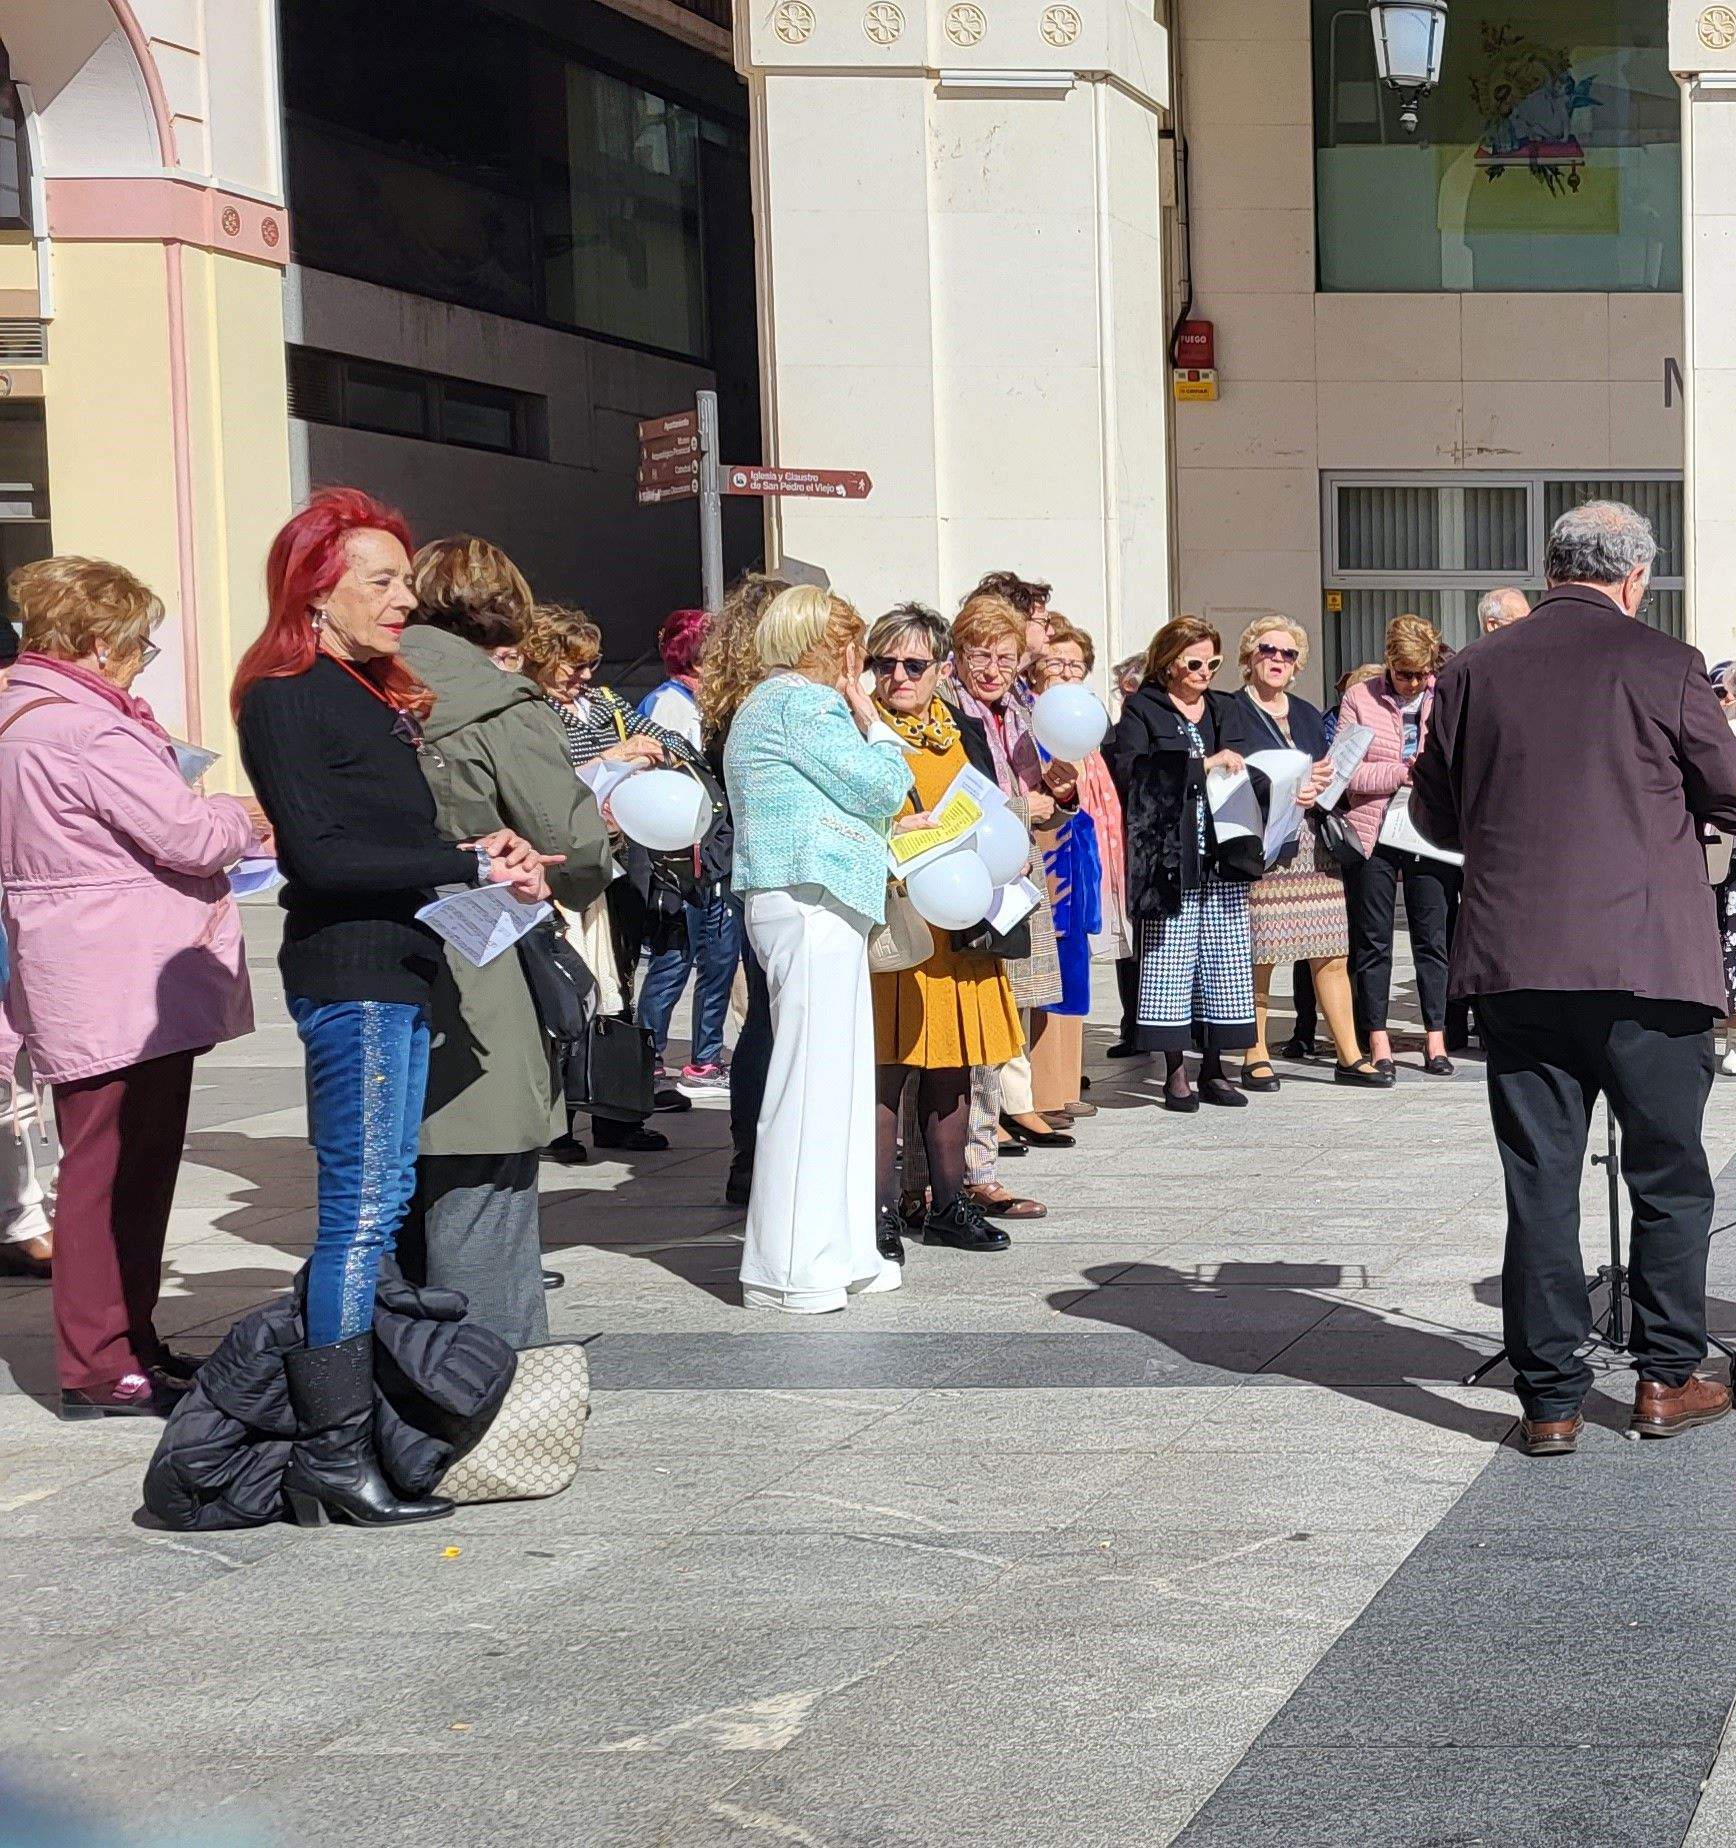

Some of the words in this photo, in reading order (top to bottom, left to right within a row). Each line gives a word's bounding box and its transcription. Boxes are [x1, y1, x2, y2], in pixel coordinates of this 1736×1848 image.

[750, 470, 777, 481] Iglesia
[778, 474, 784, 483] y
[785, 472, 819, 482] Claustro
[750, 480, 761, 490] de
[762, 481, 779, 490] San
[780, 482, 805, 491] Pedro
[806, 483, 814, 492] el
[815, 483, 835, 494] Viejo
